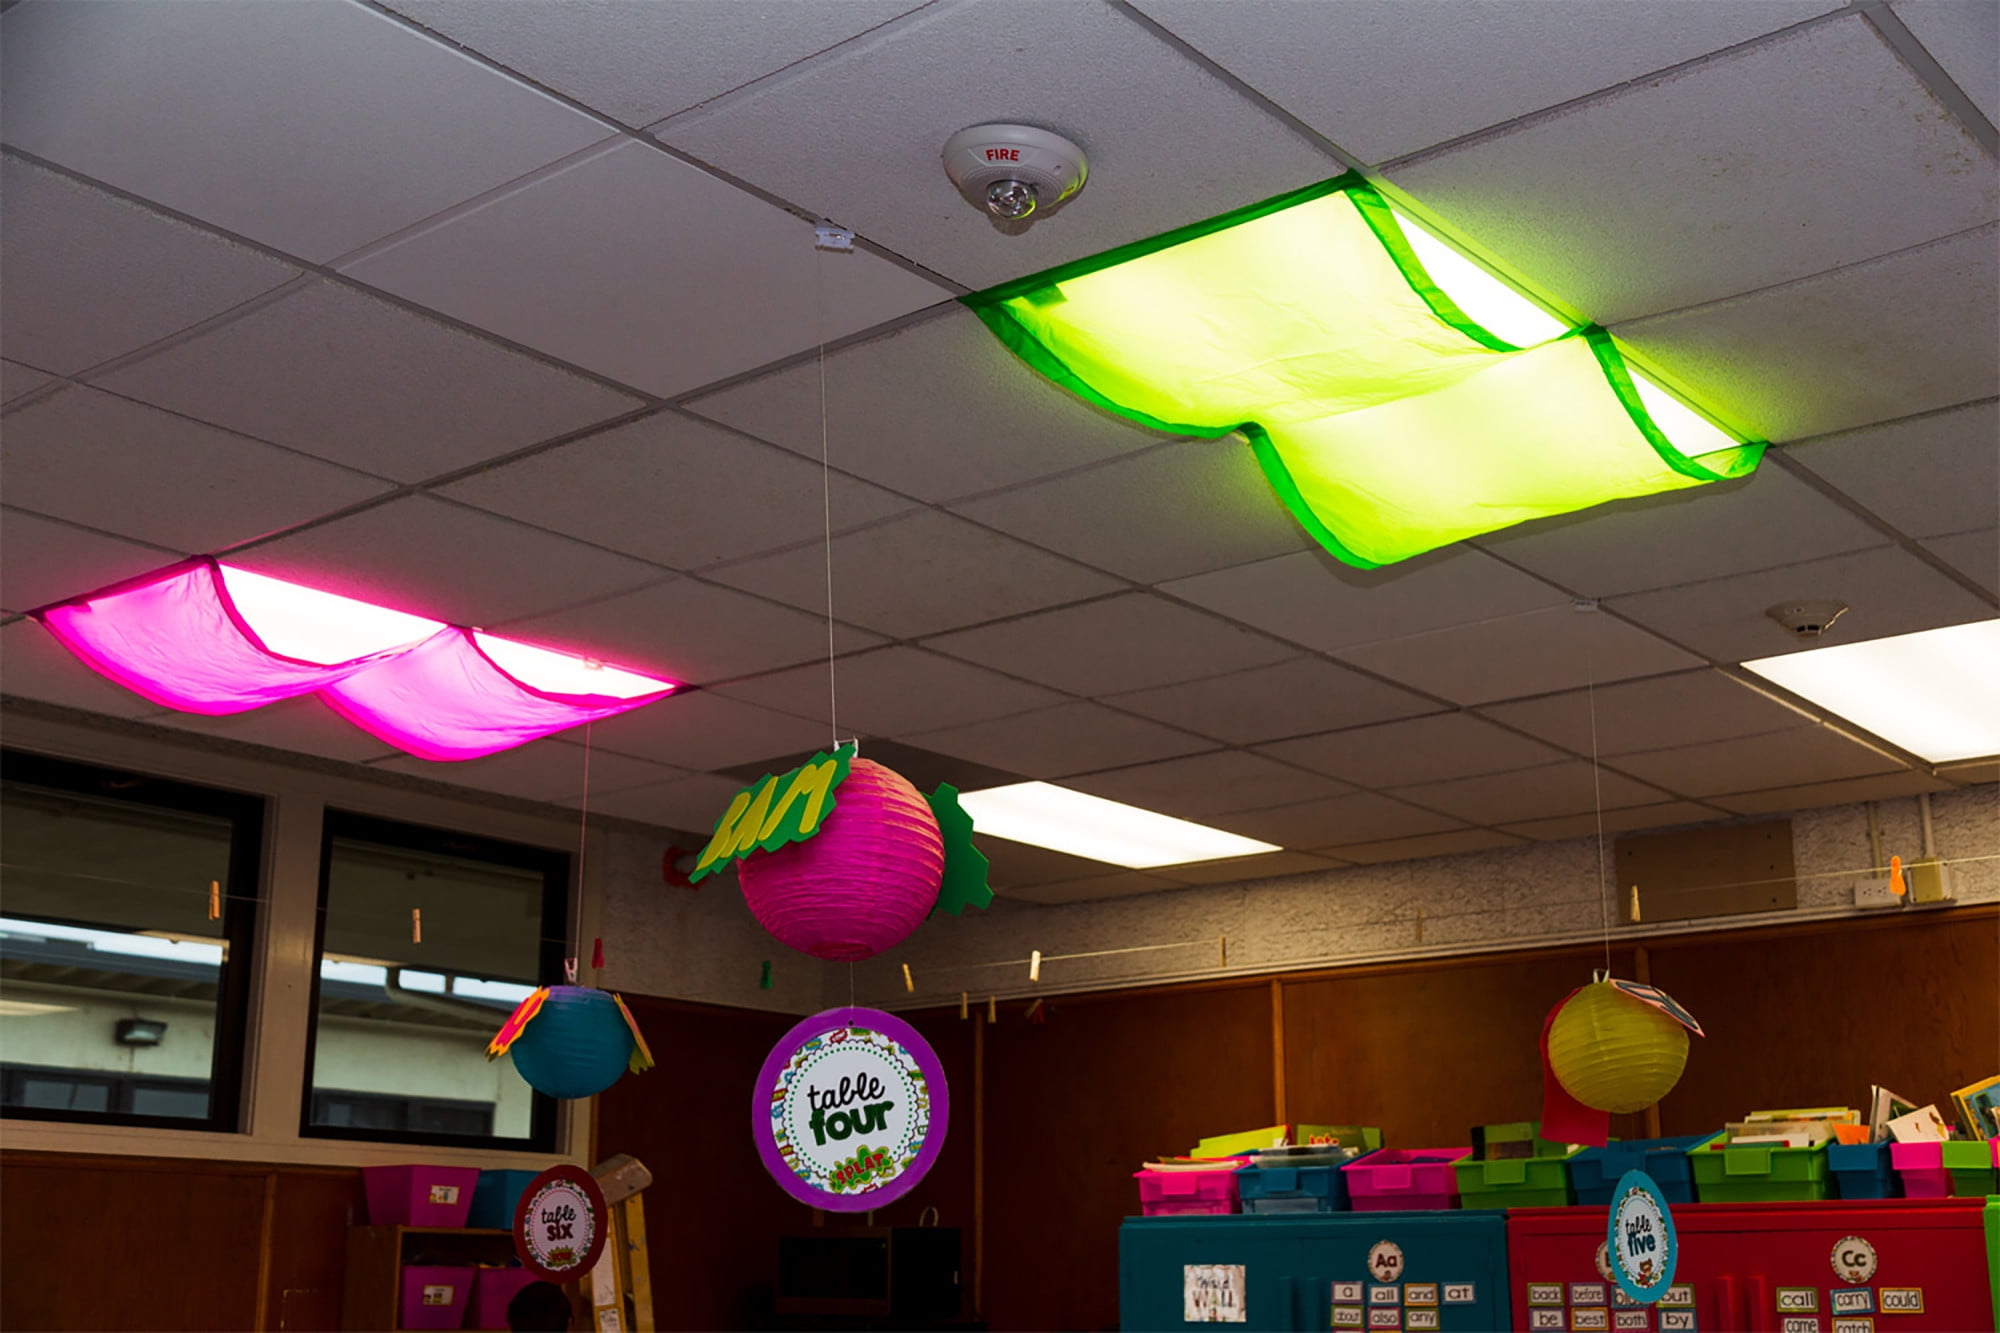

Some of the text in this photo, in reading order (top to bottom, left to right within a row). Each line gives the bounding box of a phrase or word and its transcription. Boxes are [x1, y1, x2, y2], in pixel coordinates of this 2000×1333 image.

[985, 148, 1021, 162] FIRE
[807, 1072, 886, 1111] table
[809, 1100, 895, 1147] four
[835, 1153, 884, 1184] SPLAT
[541, 1204, 577, 1225] table
[1625, 1215, 1653, 1236] table
[1627, 1233, 1657, 1257] five
[1375, 1253, 1398, 1269] Aa
[1841, 1249, 1867, 1268] Cc
[1342, 1286, 1354, 1298] a
[1374, 1289, 1394, 1301] all
[1408, 1289, 1434, 1301] and
[1447, 1288, 1470, 1300] at
[1532, 1288, 1559, 1301] back
[1574, 1288, 1603, 1300] before
[1781, 1292, 1814, 1307] call
[1836, 1292, 1868, 1309] carry
[1883, 1292, 1919, 1308] could
[1372, 1312, 1398, 1324] also
[1409, 1312, 1435, 1325] any
[1539, 1311, 1558, 1326] be
[1574, 1314, 1605, 1326] best
[1616, 1315, 1647, 1328] both
[1665, 1312, 1690, 1329] by
